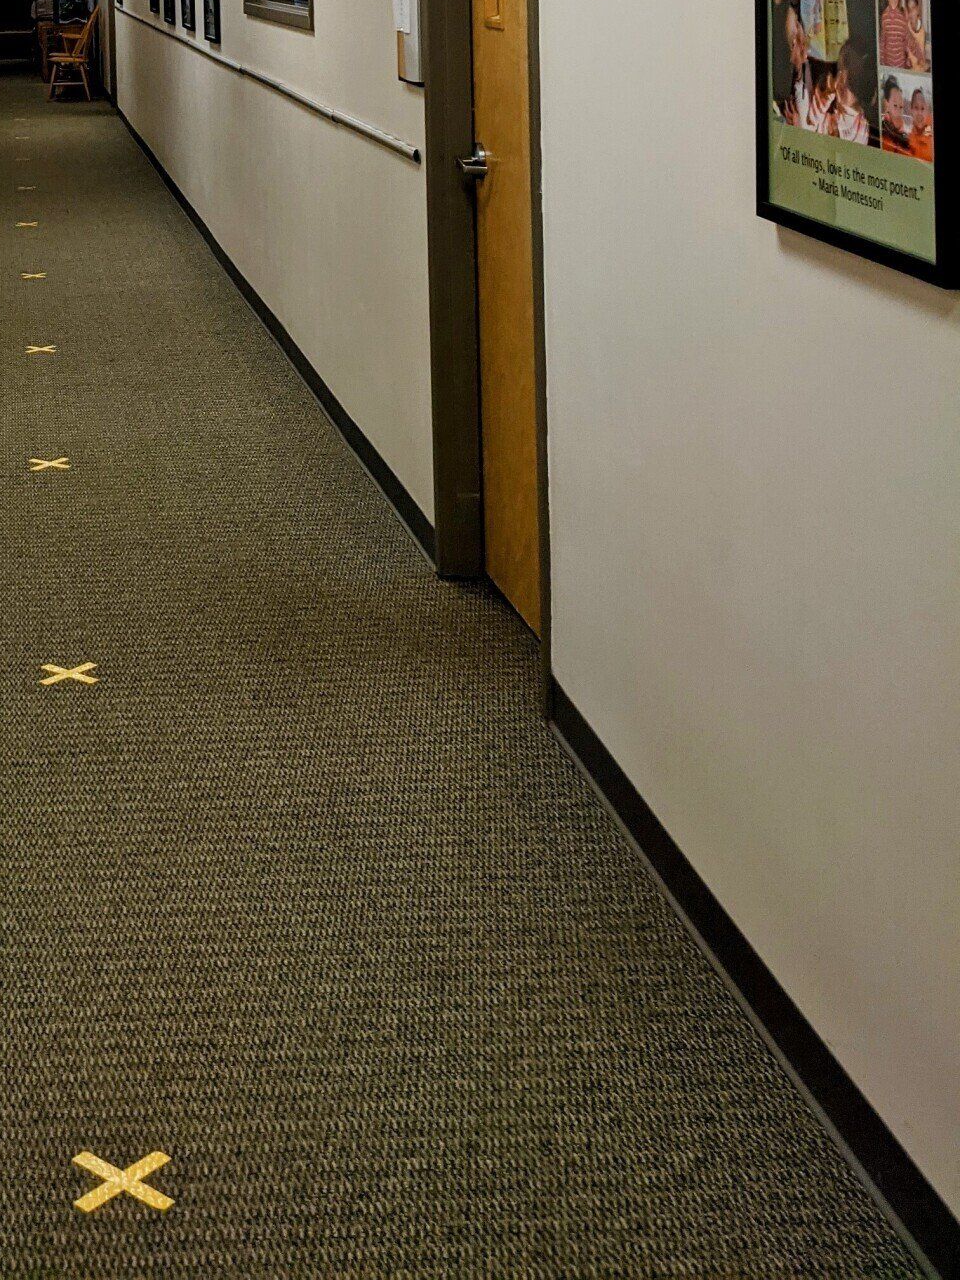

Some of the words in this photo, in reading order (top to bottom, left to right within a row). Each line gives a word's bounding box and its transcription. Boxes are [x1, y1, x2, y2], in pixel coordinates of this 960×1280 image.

[791, 149, 800, 165] all
[801, 152, 825, 174] things,
[827, 158, 842, 178] love
[844, 165, 851, 180] is
[852, 168, 866, 184] the
[867, 175, 887, 192] most
[818, 177, 839, 197] Maria
[840, 184, 884, 211] Montessori
